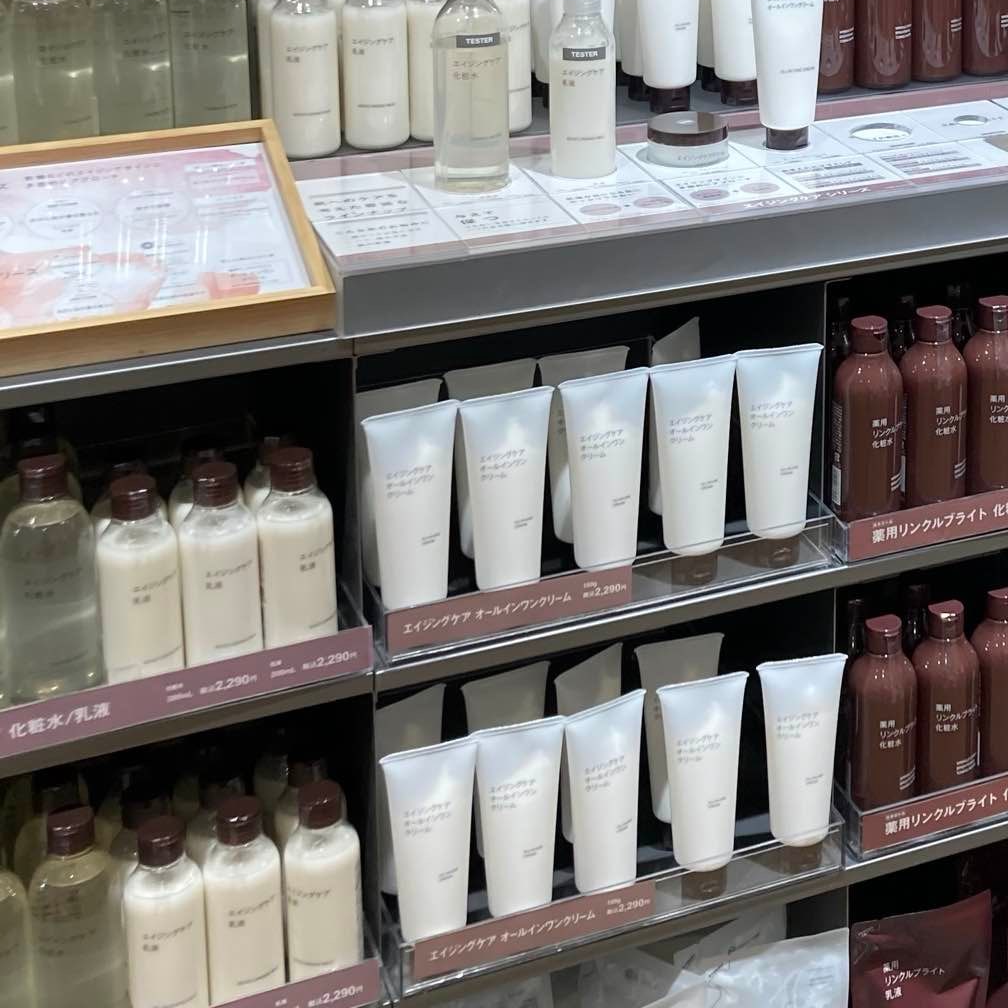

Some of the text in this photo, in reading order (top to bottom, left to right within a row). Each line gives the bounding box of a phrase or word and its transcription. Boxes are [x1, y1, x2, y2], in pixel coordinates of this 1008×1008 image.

[351, 38, 394, 46] エイジングケア
[465, 36, 493, 45] TESTER
[571, 50, 598, 58] TESTER
[989, 394, 1006, 403] 薬用
[935, 406, 950, 415] 薬用
[872, 418, 888, 427] 薬用
[935, 426, 957, 436] 化粧水
[872, 438, 893, 449] 化粧水
[872, 507, 988, 544] 薬用リンクルブライト
[403, 592, 572, 635] エイジングケア オールインワンクリーム
[935, 703, 952, 712] 薬用
[8, 701, 111, 739] 化粧水/乳液
[879, 719, 896, 729] 薬用
[935, 723, 959, 733] 化粧水
[879, 739, 902, 749] 化粧水
[884, 793, 999, 836] 薬用リンクルブライト
[428, 910, 596, 961] エイジングケア オールインワンクリーム
[884, 967, 946, 987] リンクルブライト
[885, 987, 902, 1001] 乳液
